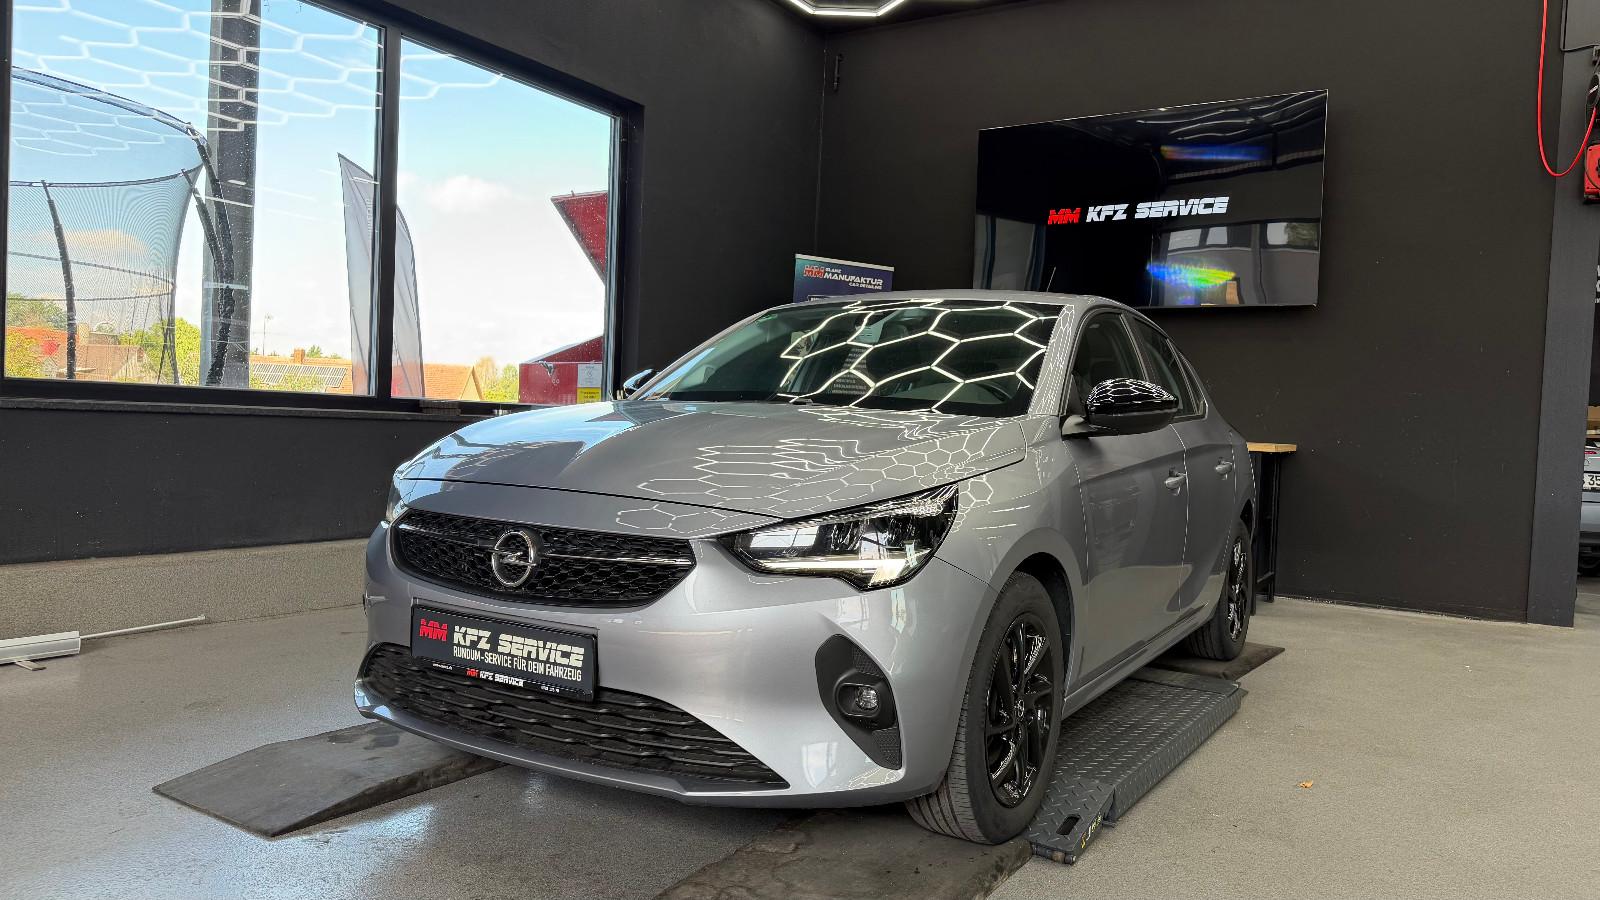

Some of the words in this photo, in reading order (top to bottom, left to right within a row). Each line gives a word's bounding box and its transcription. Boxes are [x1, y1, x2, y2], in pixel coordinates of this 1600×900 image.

[1047, 208, 1081, 224] MM
[1086, 204, 1130, 222] KFZ
[1135, 197, 1229, 219] SERVICE
[824, 272, 883, 285] MANUFAKTUR
[419, 619, 448, 641] MM
[453, 625, 491, 650] KFZ
[498, 633, 584, 667] SERVICE
[453, 646, 512, 669] RUNDUM-SERVICE
[513, 655, 527, 671] FÜR
[528, 660, 544, 675] DEIN
[545, 663, 582, 682] FAHRZEUG
